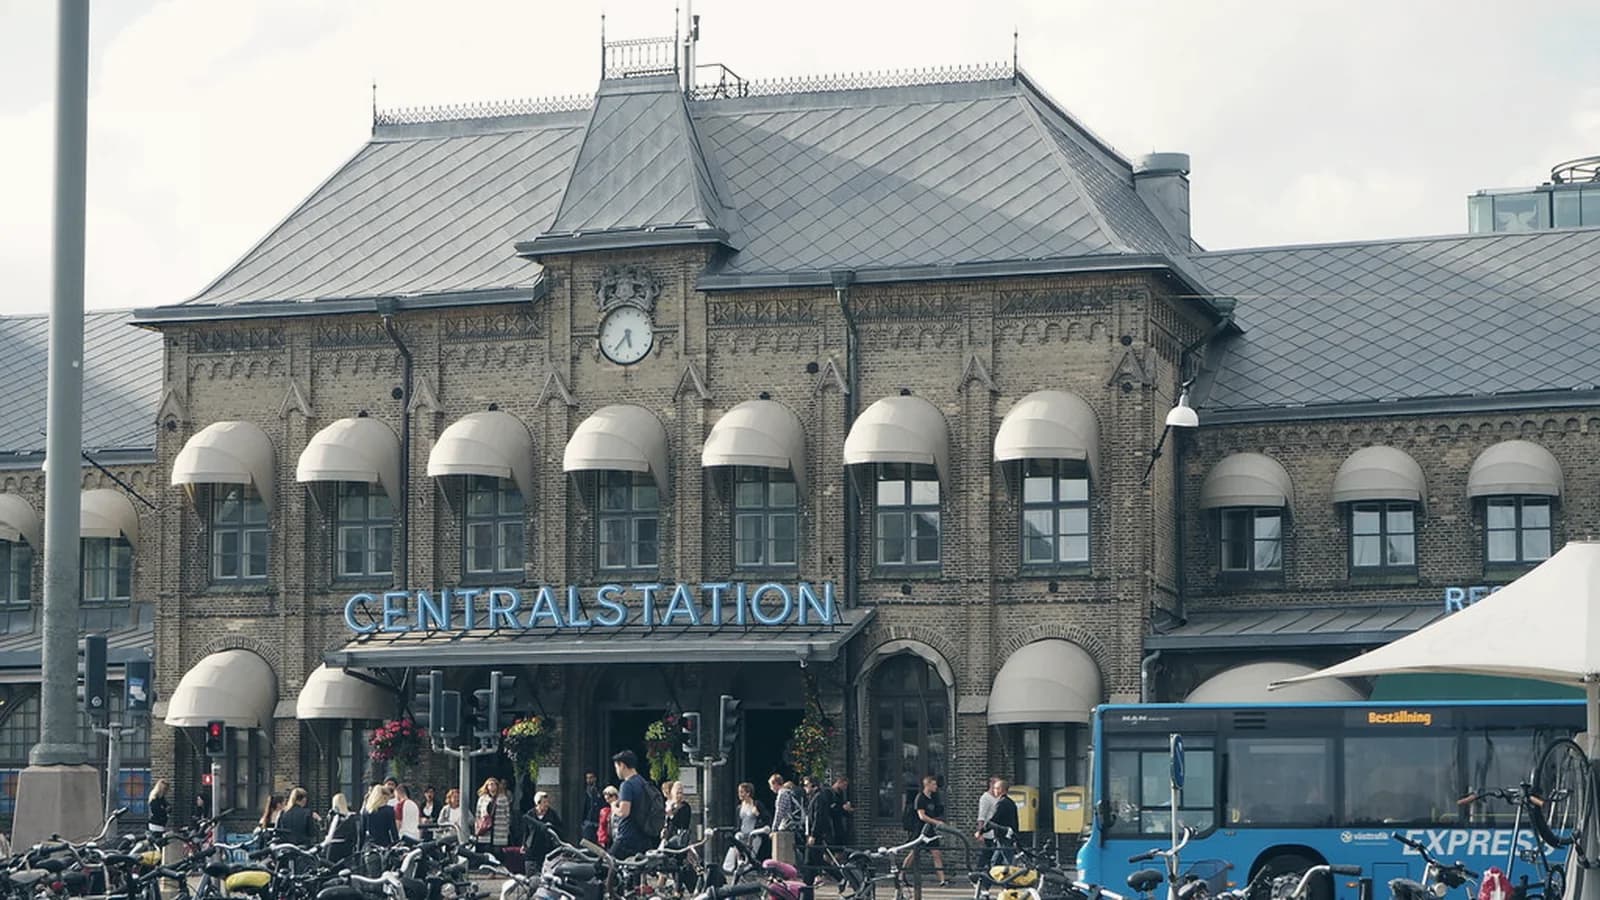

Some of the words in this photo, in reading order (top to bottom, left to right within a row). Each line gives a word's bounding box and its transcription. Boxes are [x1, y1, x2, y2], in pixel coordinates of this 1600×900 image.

[344, 581, 835, 634] CENTRALSTATION
[1445, 585, 1504, 614] RE
[1368, 710, 1432, 726] Beställning
